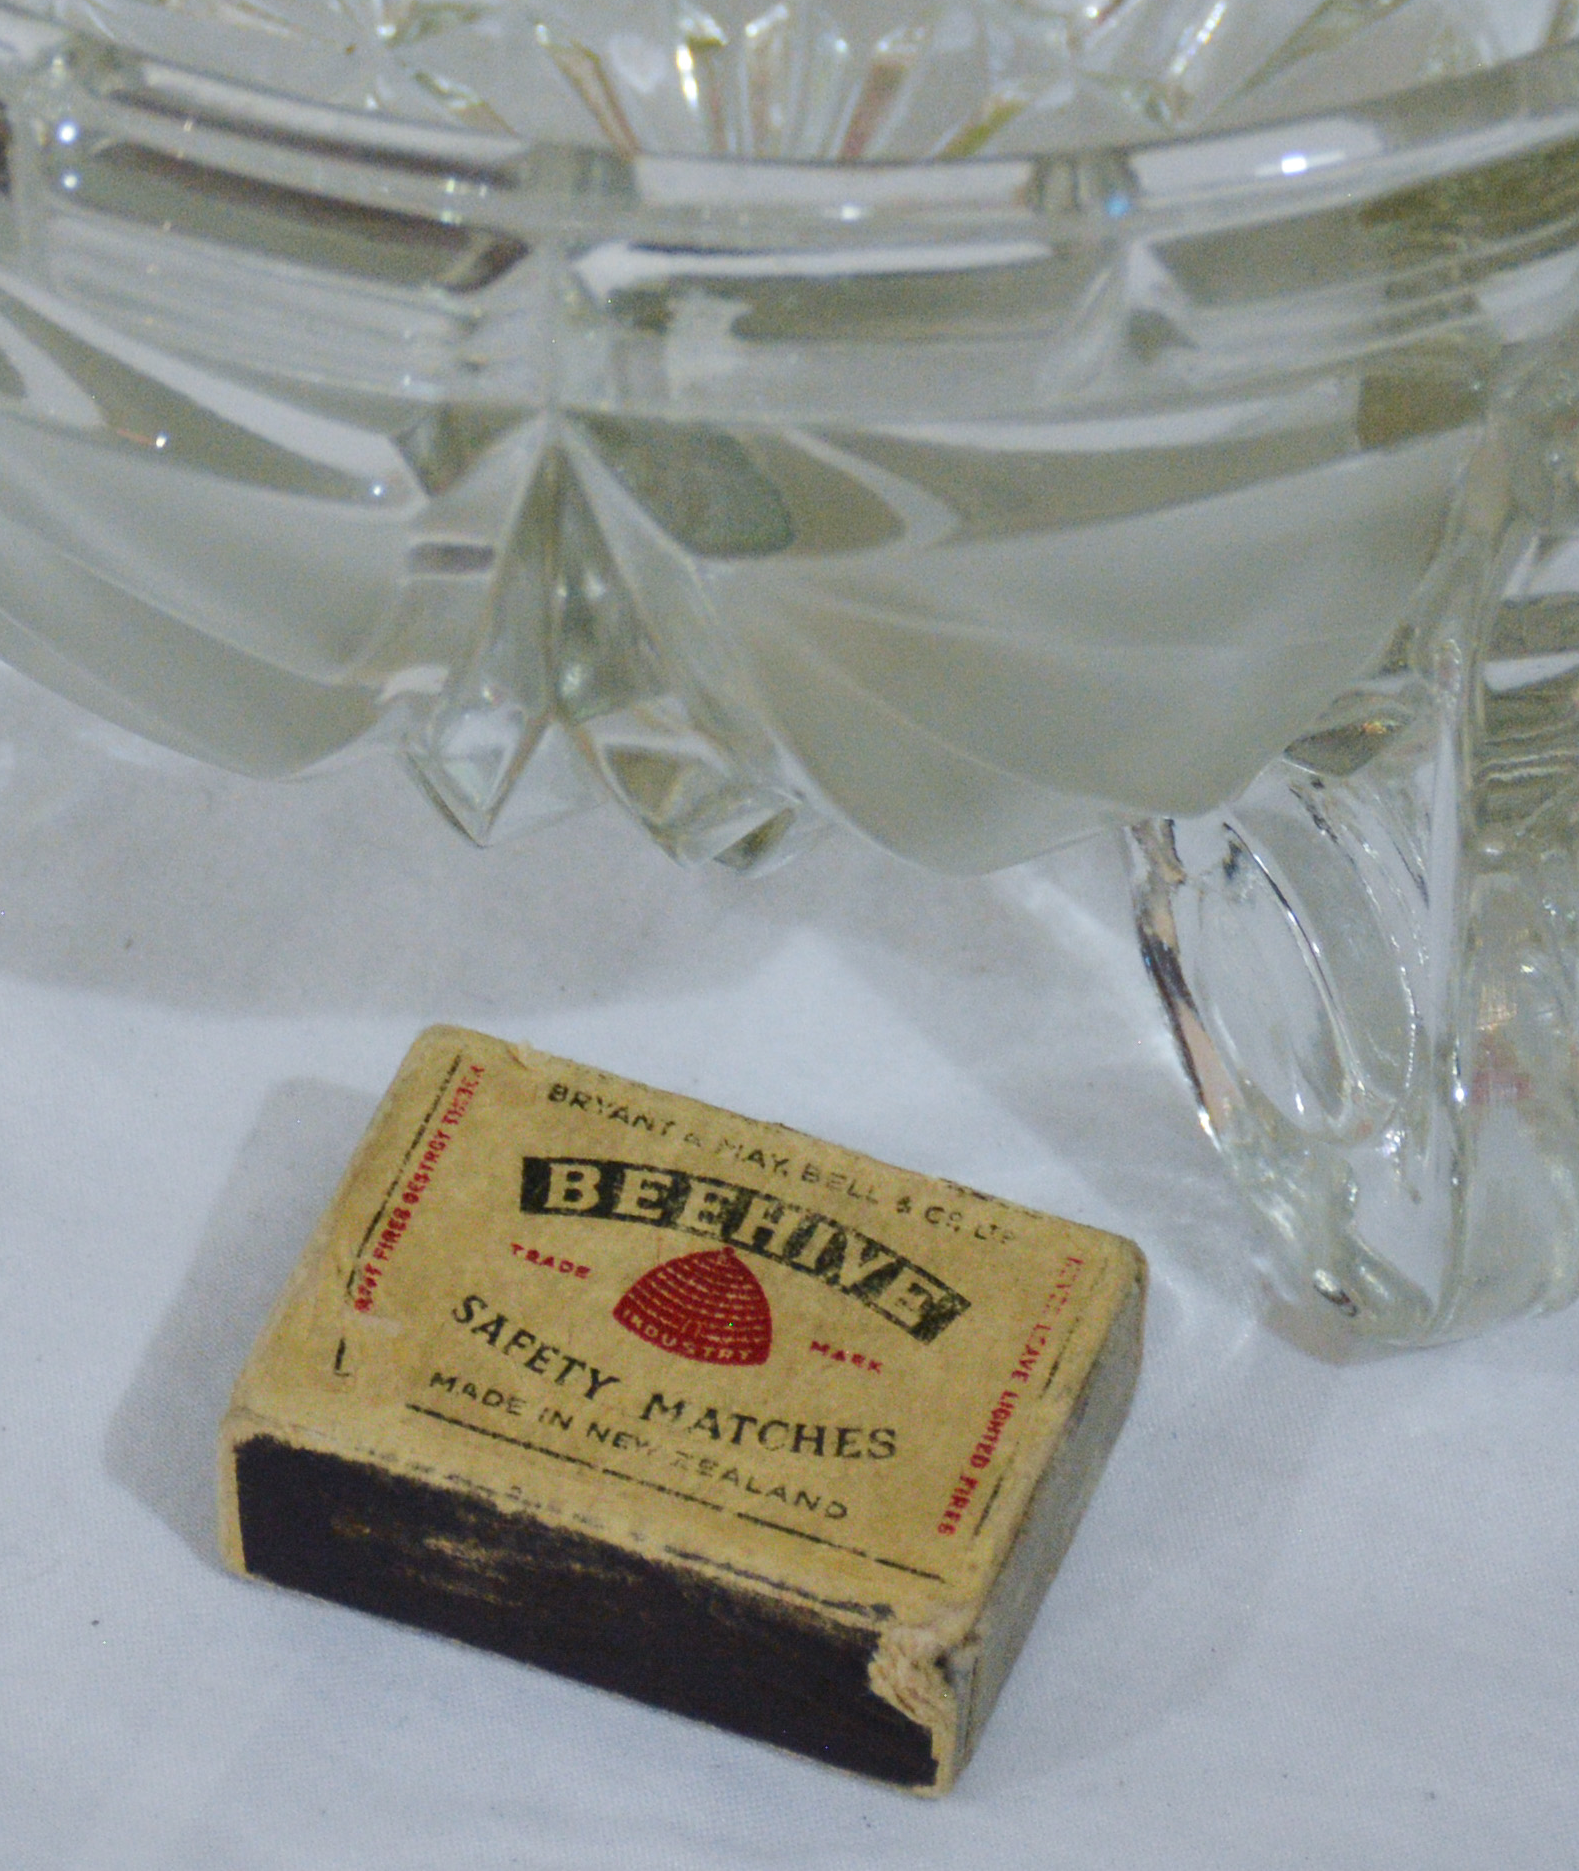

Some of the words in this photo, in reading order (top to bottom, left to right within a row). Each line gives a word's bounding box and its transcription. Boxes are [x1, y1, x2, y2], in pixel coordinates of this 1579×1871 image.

[547, 1082, 676, 1136] BRYANT
[801, 1161, 879, 1205] BELL
[895, 1194, 912, 1214] &
[510, 1241, 591, 1280] TRADE
[543, 1162, 951, 1333] BEEHIVE
[451, 1294, 621, 1401] SAFETY
[639, 1392, 898, 1461] MATCHES
[620, 1308, 753, 1361] INDUSTRY
[810, 1339, 884, 1375] MARK
[428, 1371, 525, 1417] MADE
[537, 1406, 574, 1432] IN
[585, 1420, 656, 1457] NEW
[673, 1449, 849, 1520] ZEALAND
[970, 1389, 1020, 1471] LIGHTED
